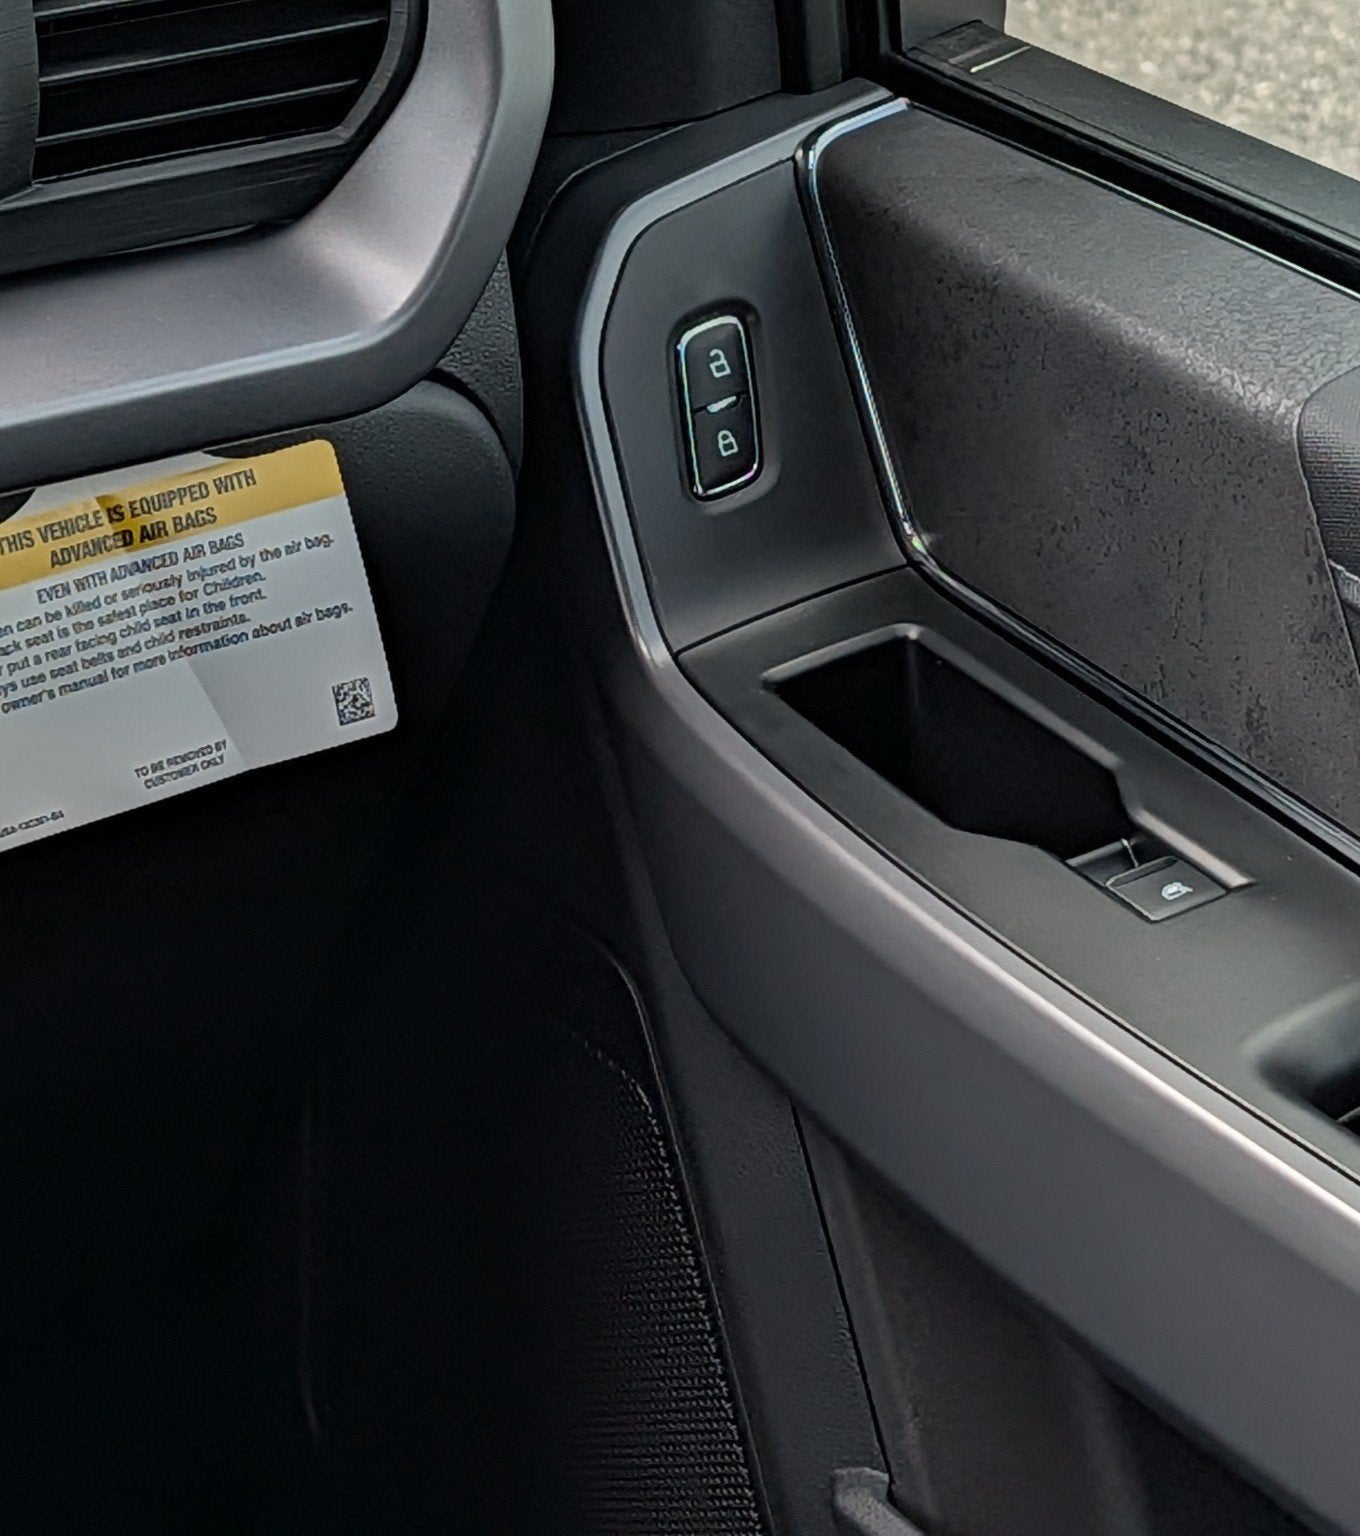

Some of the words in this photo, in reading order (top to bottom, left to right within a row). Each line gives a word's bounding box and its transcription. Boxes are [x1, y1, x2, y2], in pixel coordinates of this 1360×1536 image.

[36, 510, 103, 543] VEHICLE
[105, 503, 125, 524] IS
[128, 481, 209, 518] EQUIPPED
[212, 468, 256, 494] WITH
[50, 529, 133, 568] ADVANCED
[139, 520, 169, 543] AIR
[171, 506, 216, 533] BAGS
[36, 581, 71, 604] EVEN
[72, 570, 107, 592] WITH
[110, 551, 178, 582] ADVANCED
[182, 543, 206, 563] AIR
[208, 532, 244, 554] BAGS
